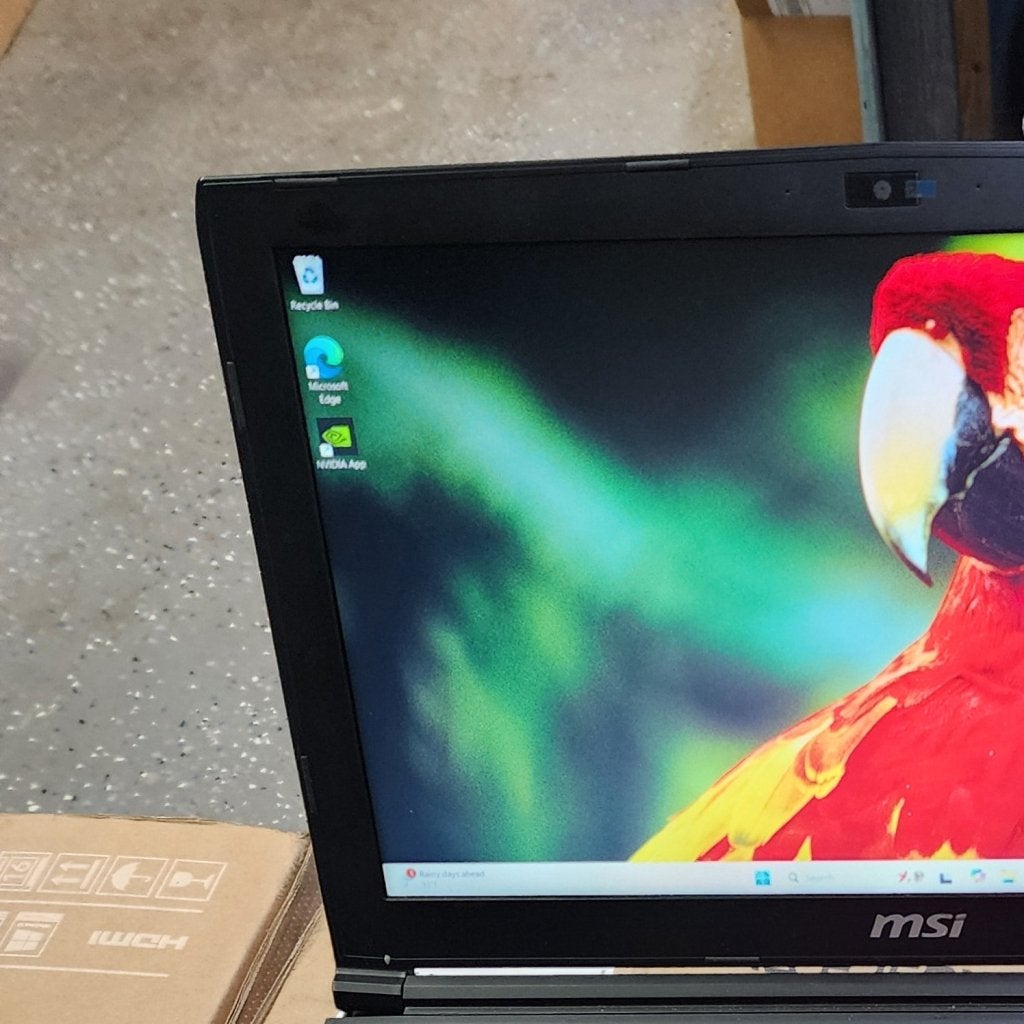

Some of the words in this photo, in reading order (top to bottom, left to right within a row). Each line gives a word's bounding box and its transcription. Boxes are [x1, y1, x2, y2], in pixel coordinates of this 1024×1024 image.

[290, 300, 323, 313] Recycle
[324, 299, 340, 311] Bin
[308, 381, 349, 392] Microsoft
[318, 394, 342, 406] Edge
[316, 459, 348, 470] NVIDIA
[349, 460, 367, 471] App
[869, 913, 967, 938] msi
[87, 930, 189, 950] HDMI
